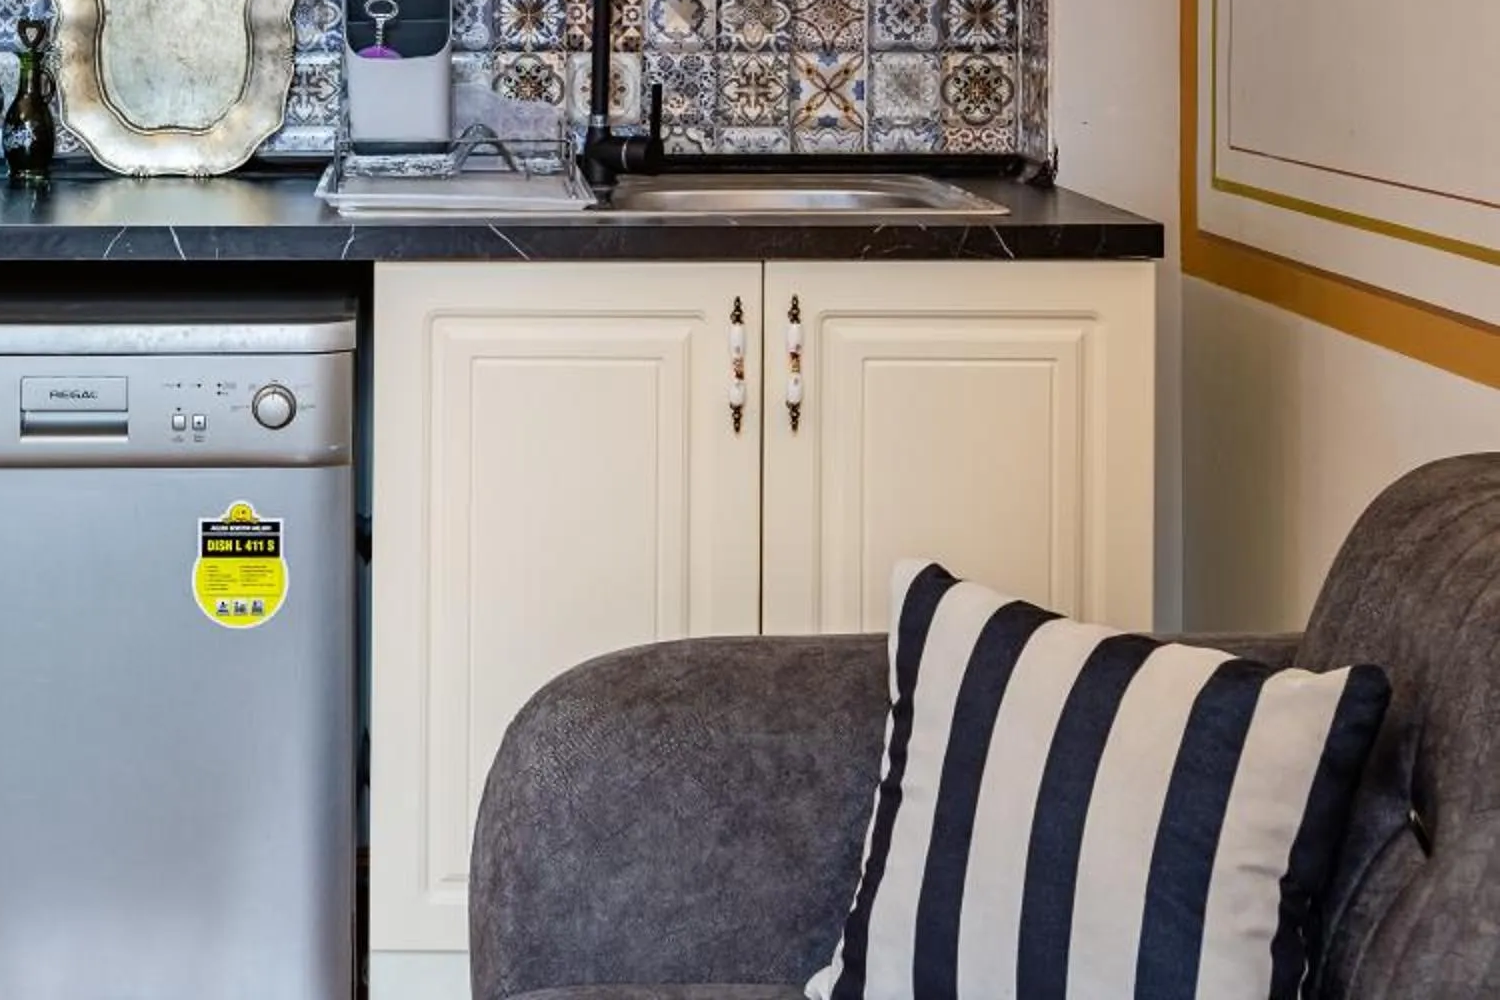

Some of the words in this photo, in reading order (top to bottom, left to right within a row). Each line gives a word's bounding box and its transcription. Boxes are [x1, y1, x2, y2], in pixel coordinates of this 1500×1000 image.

[207, 539, 233, 552] DISH
[235, 539, 243, 551] L
[245, 539, 264, 552] 411
[267, 539, 275, 552] S
